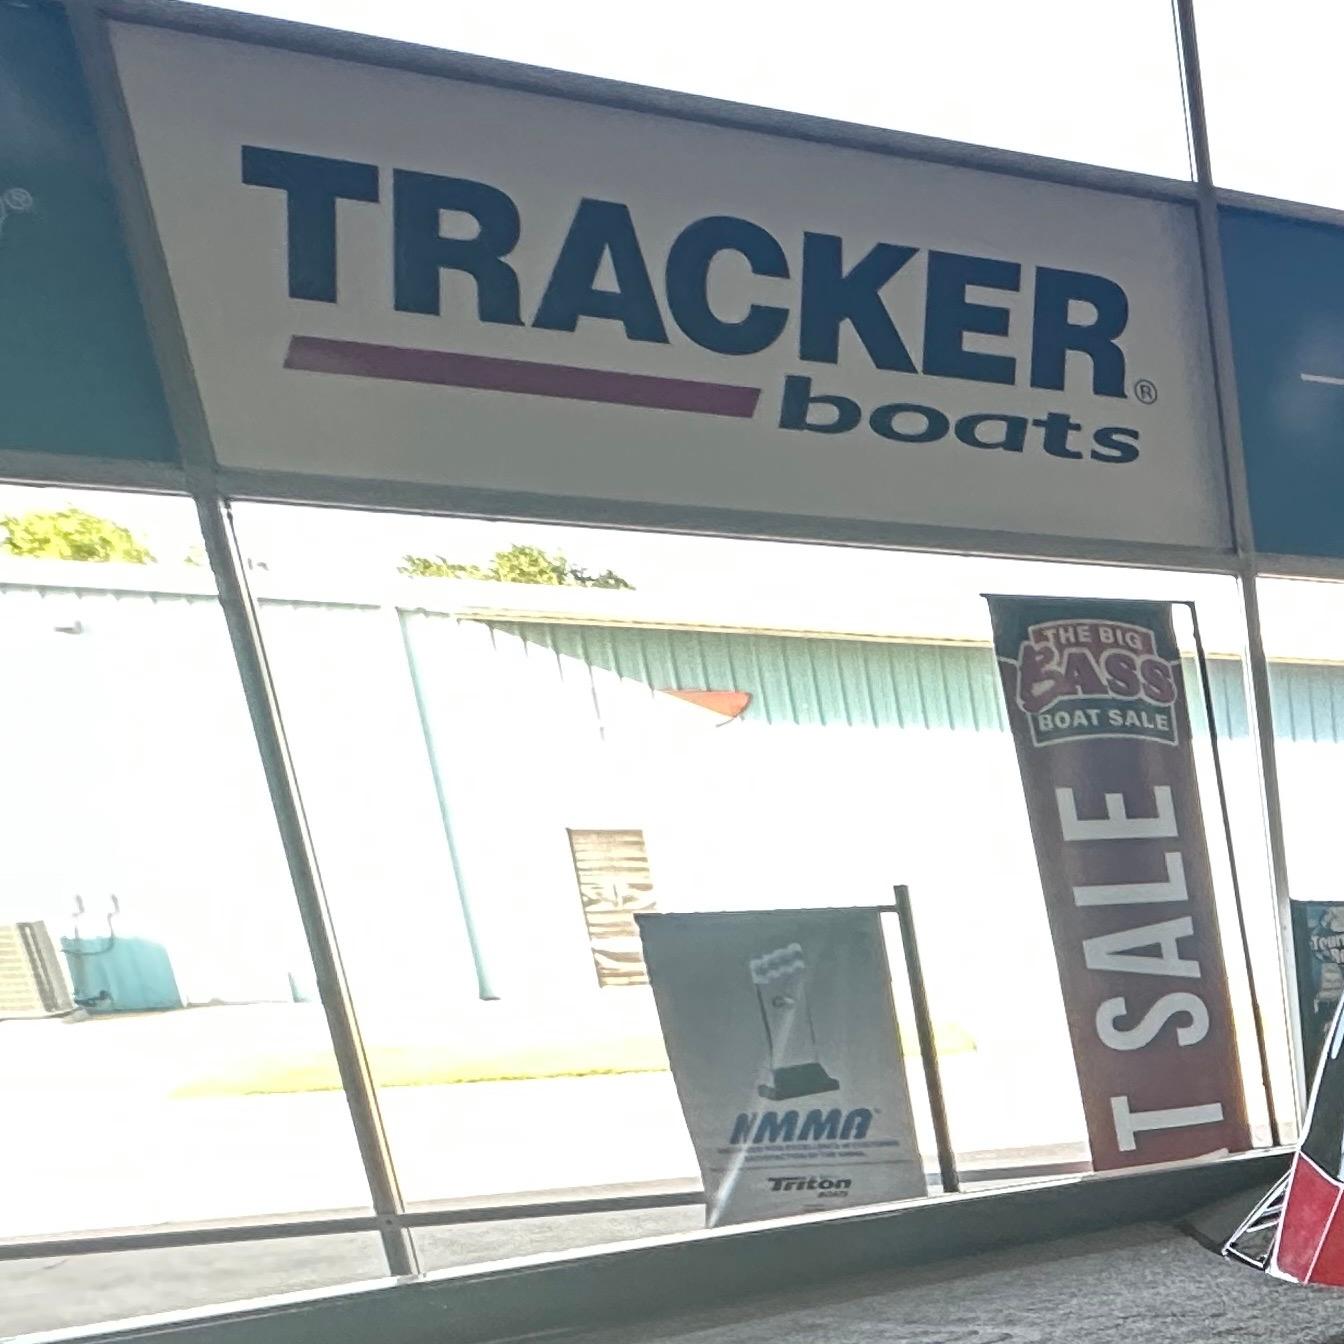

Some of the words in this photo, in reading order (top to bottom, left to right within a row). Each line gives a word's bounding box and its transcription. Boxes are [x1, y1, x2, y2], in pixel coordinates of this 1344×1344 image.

[241, 145, 1129, 398] TRACKER
[778, 374, 1141, 465] boats
[1043, 625, 1093, 645] THE
[1099, 627, 1142, 650] BIG
[1018, 641, 1177, 714] BASS
[1038, 708, 1101, 732] BOAT
[1108, 708, 1170, 732] SALE
[1055, 785, 1210, 1052] SALE
[730, 1107, 874, 1145] NMMA
[1110, 1095, 1226, 1155] T
[768, 1176, 852, 1192] Triton
